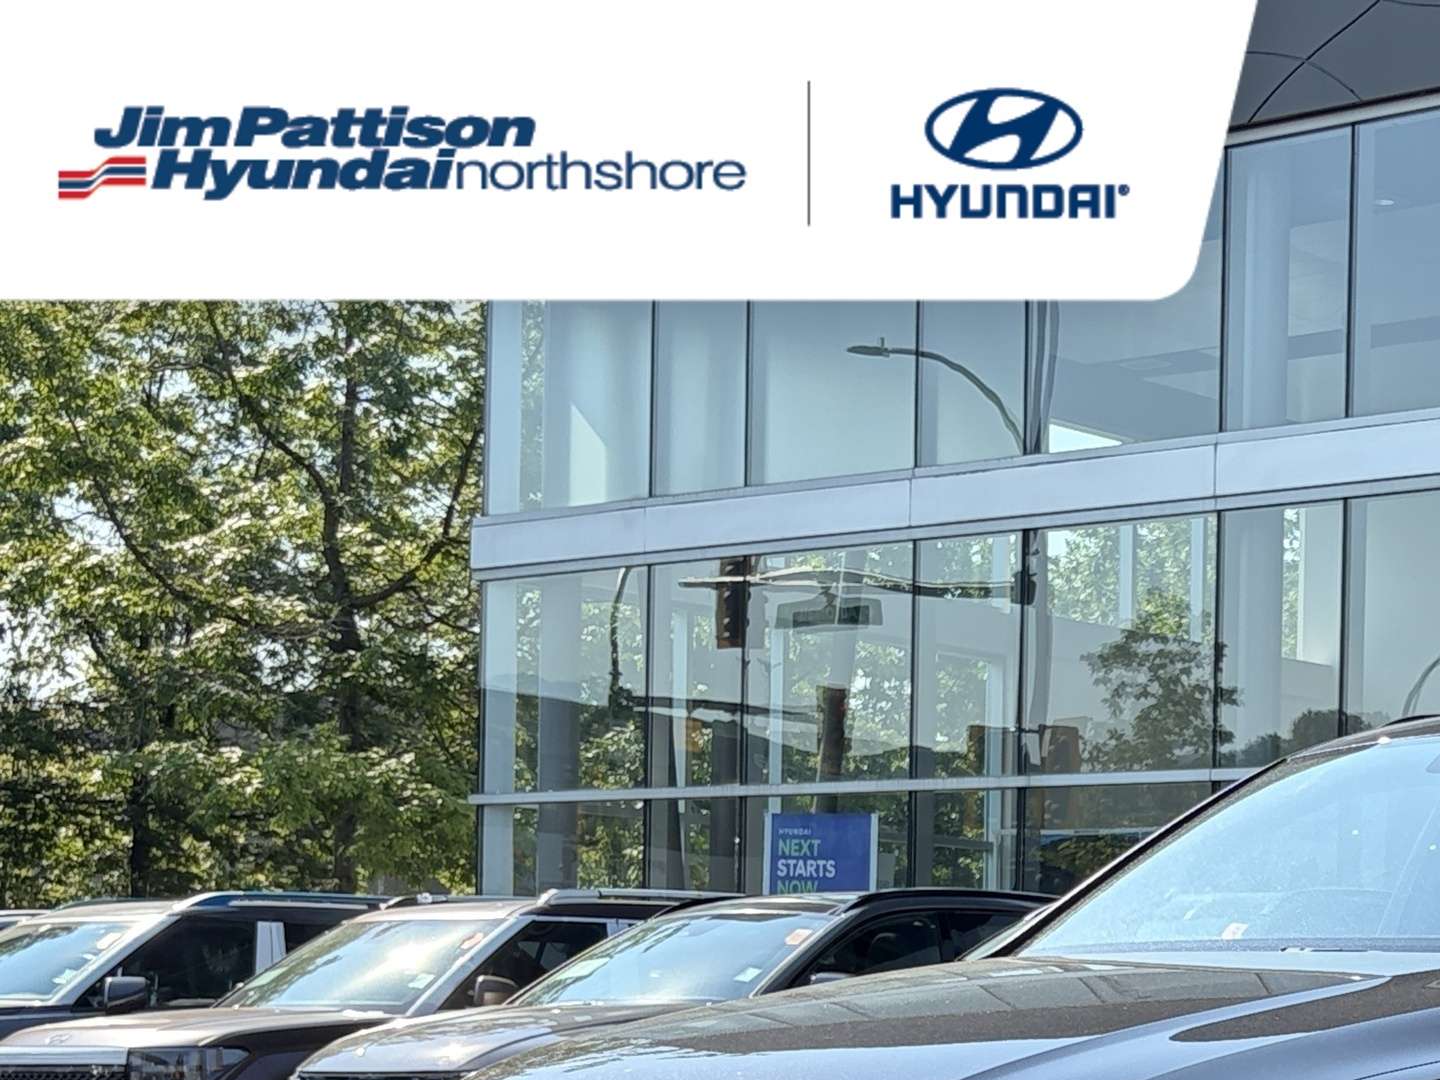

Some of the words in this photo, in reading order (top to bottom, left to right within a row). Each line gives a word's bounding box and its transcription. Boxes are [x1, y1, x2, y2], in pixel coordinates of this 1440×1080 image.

[778, 839, 821, 856] NEXT
[777, 859, 836, 878] STARTS
[777, 880, 818, 894] NOW
